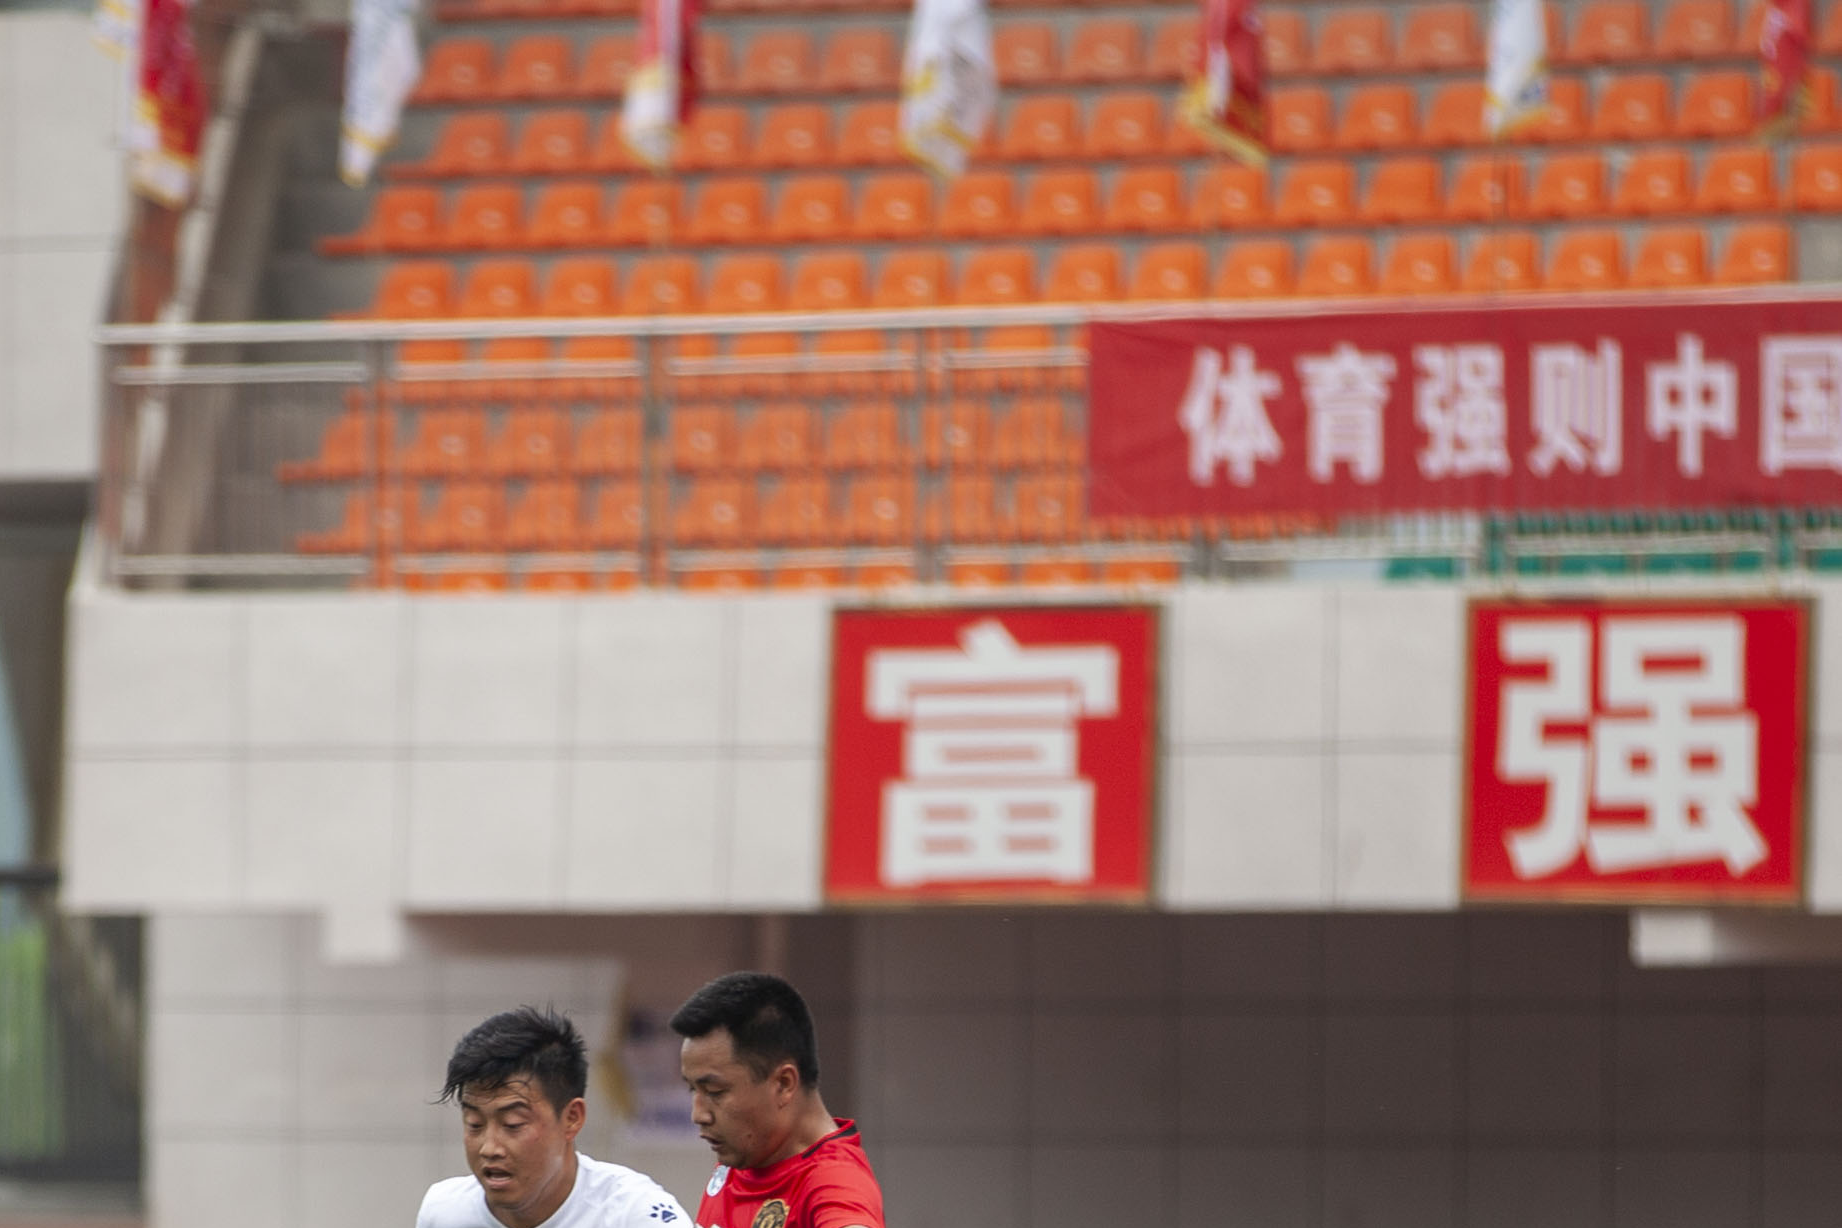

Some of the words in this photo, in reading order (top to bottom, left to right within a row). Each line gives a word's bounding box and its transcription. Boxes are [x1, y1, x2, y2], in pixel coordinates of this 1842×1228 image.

[1179, 333, 1842, 485] 体育强则中国
[865, 620, 1120, 888] 富
[1498, 616, 1767, 879] 强
